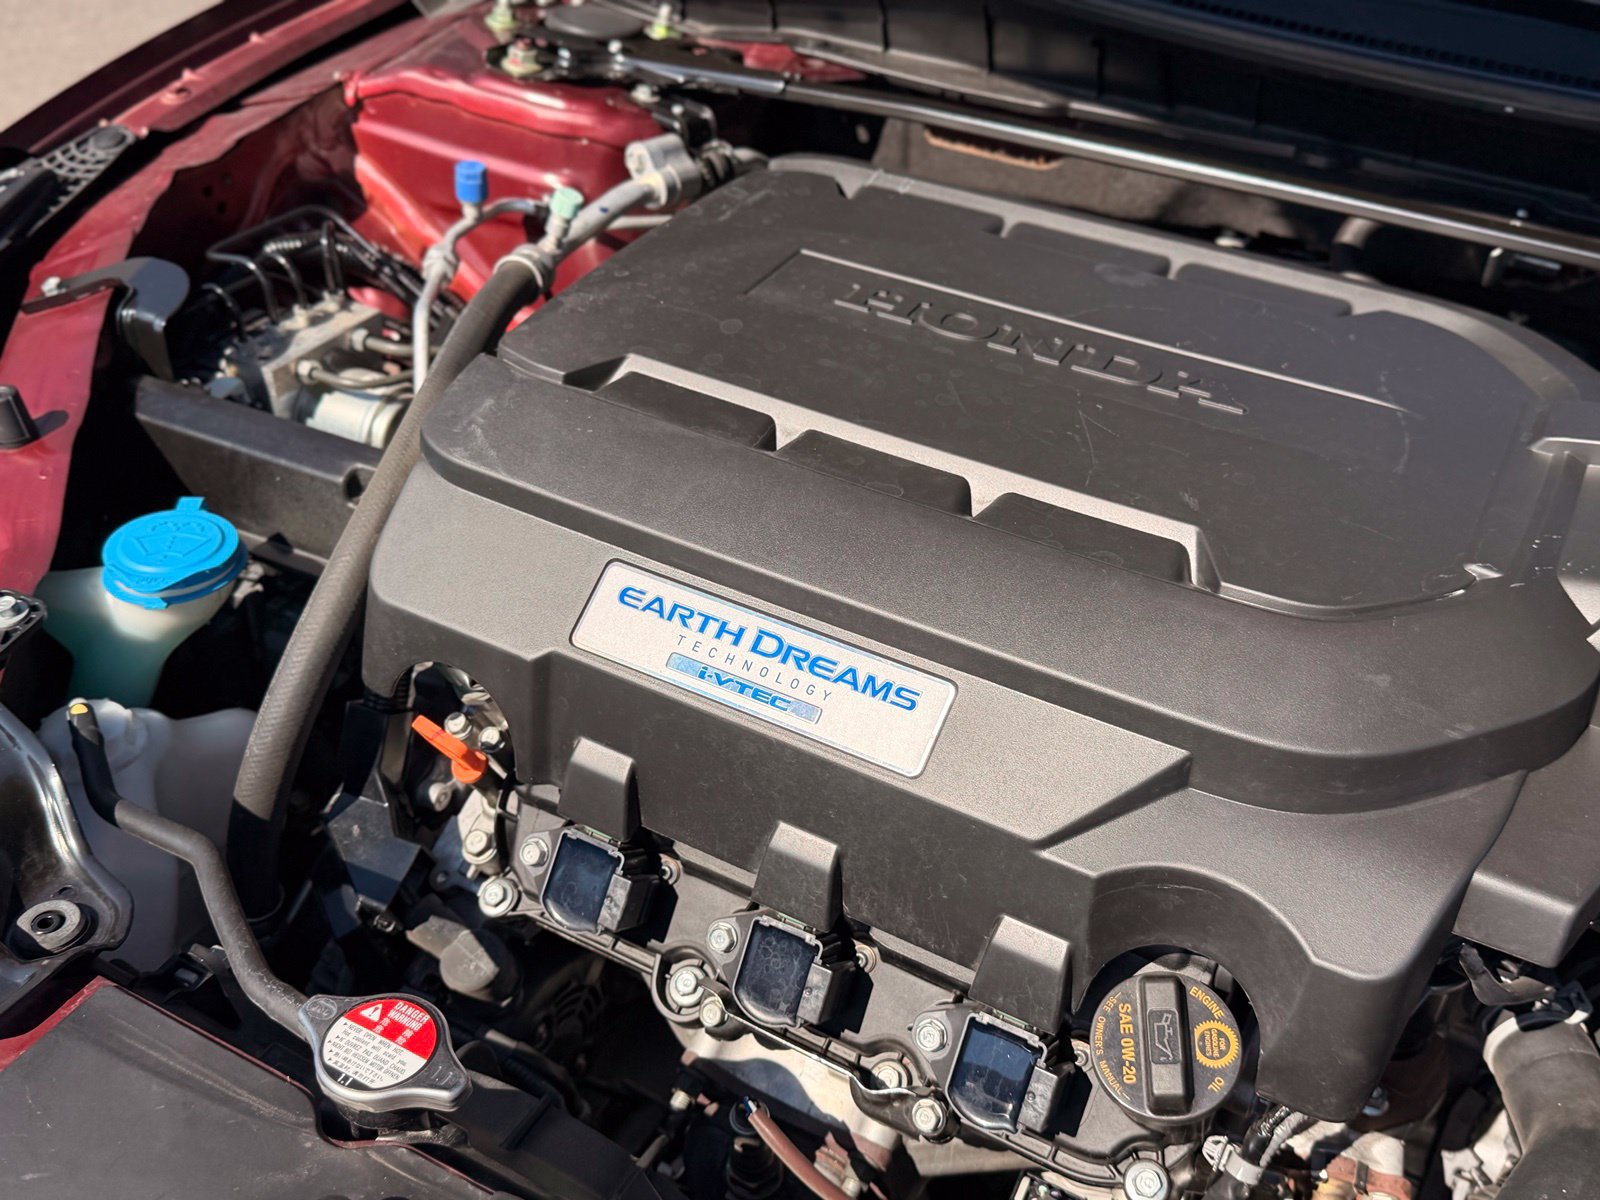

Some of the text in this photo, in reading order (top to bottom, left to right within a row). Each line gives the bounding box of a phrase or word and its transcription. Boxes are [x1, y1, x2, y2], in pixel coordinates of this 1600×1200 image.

[834, 283, 1248, 414] HONDA
[618, 586, 922, 711] EARTH DREAMS
[676, 634, 832, 701] TECHNOLOGY
[698, 665, 792, 711] i-VTEC
[394, 1001, 431, 1024] DANGER
[1094, 1015, 1106, 1055] OWNER'S
[1189, 986, 1225, 1093] ENGINE OIL
[1118, 1003, 1137, 1085] SAE 0W-20
[1211, 1028, 1220, 1058] GASOLINE
[337, 1073, 354, 1087] 1.1
